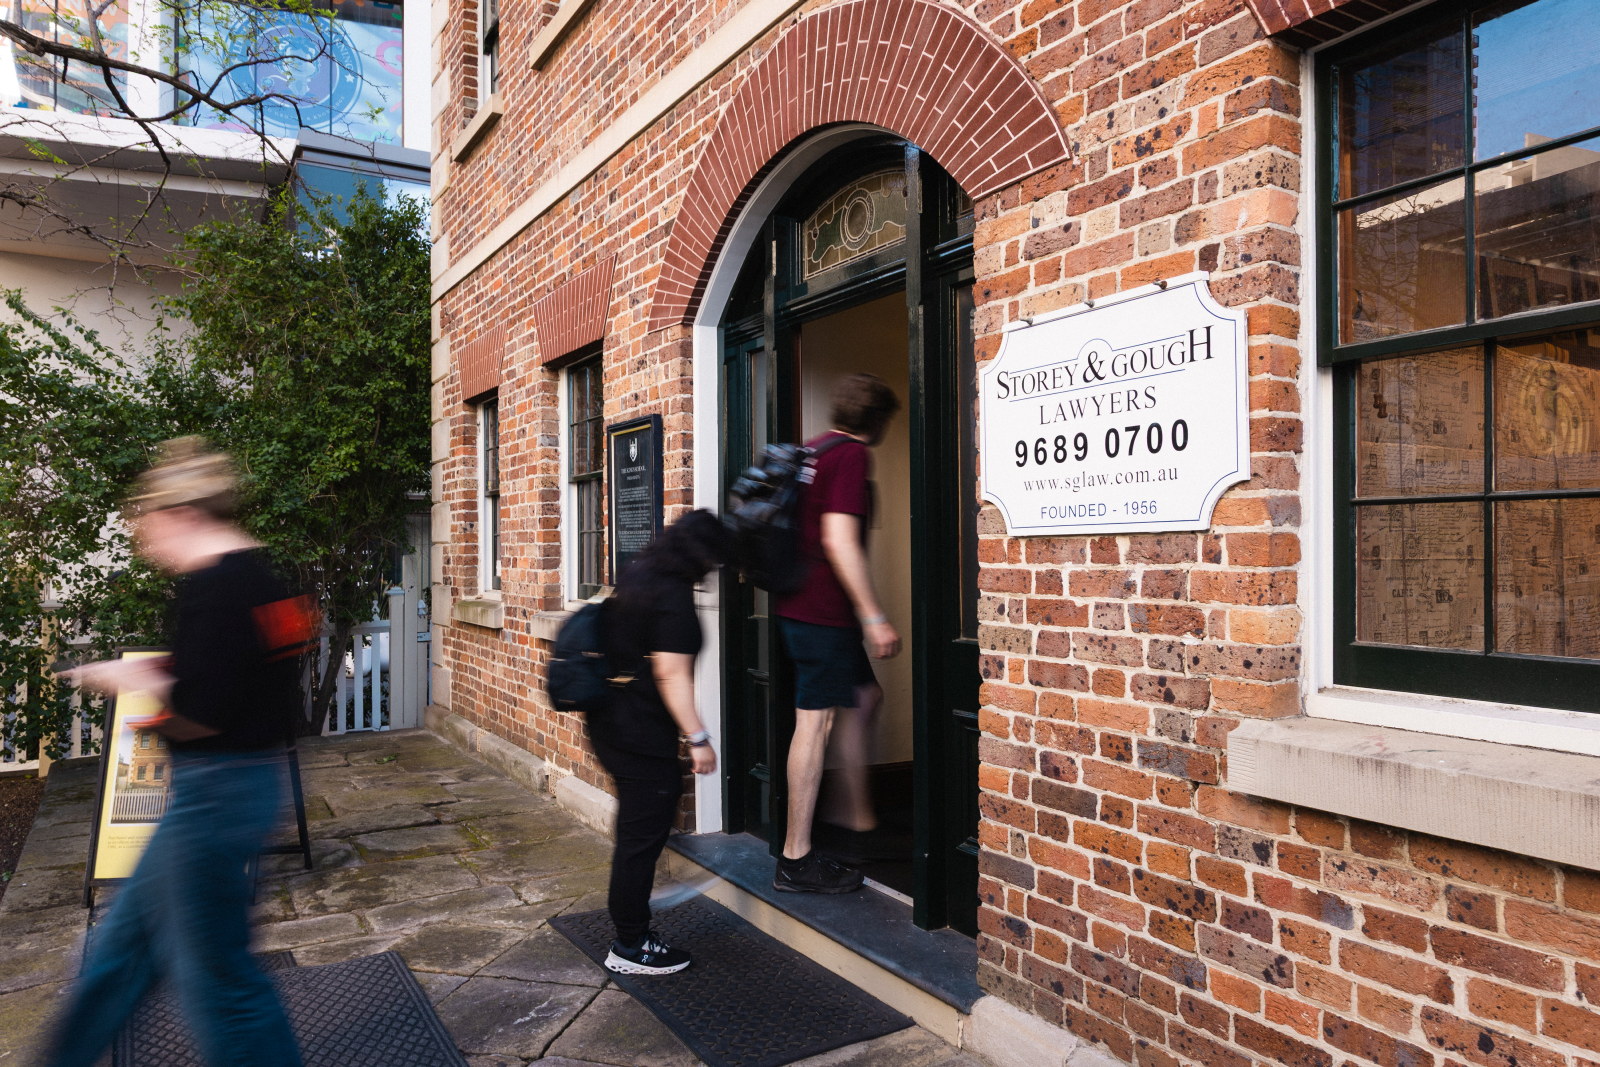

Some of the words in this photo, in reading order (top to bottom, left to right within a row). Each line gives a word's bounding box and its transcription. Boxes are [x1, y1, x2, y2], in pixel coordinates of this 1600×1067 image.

[997, 363, 1078, 400] STOREY
[1082, 350, 1106, 383] &
[1111, 325, 1214, 378] GOUGH
[1039, 385, 1157, 425] LAWYERS
[1015, 432, 1088, 467] 9689
[1104, 419, 1189, 458] 0700
[1023, 466, 1178, 492] www.sglaw.com.au
[1040, 503, 1107, 519] FOUNDED
[1123, 500, 1158, 515] 1956
